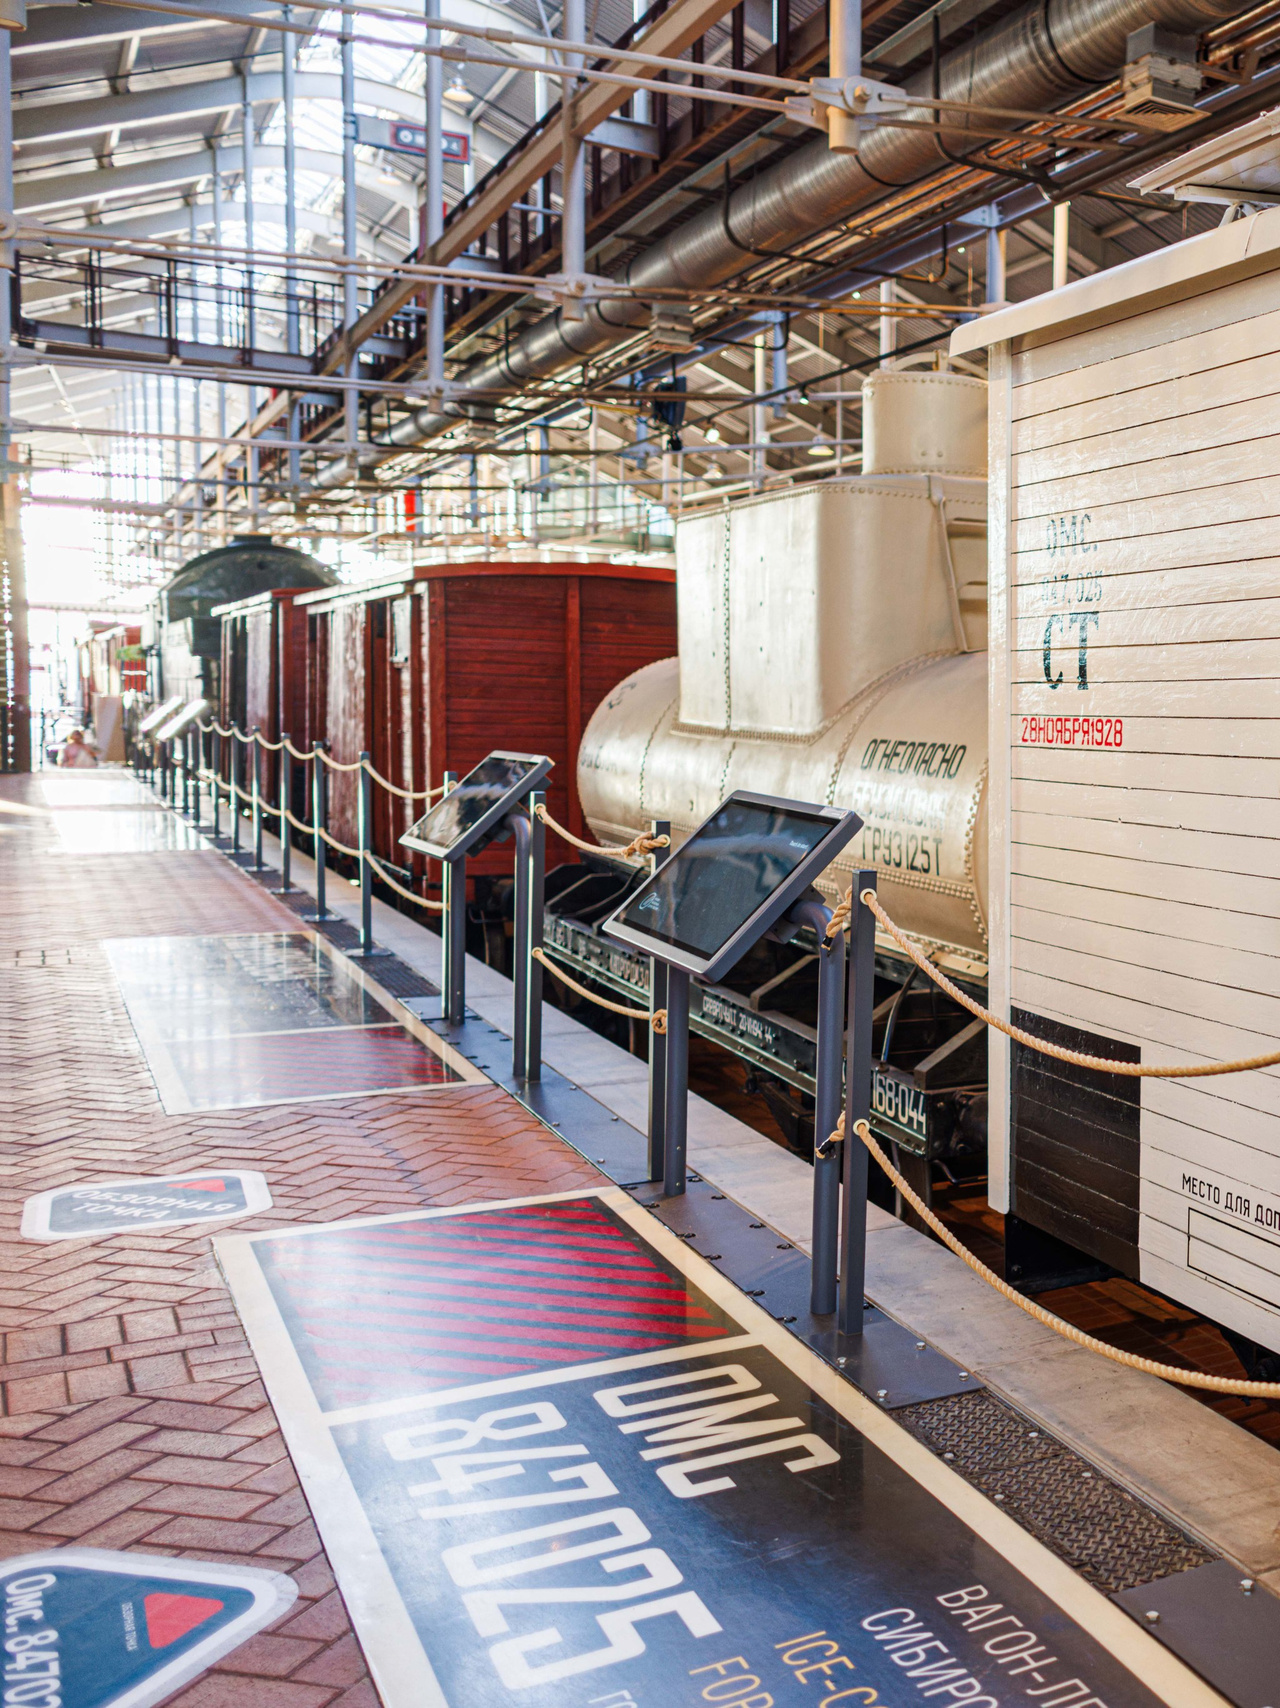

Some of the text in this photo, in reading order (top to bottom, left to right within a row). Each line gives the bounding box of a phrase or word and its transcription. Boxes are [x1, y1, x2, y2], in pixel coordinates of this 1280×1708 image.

[1043, 611, 1100, 690] СТ
[860, 738, 967, 779] ОГНЕОПАСНО
[72, 1190, 236, 1213] ОБЗОРНАЯ
[72, 1202, 170, 1219] ТОЧКА
[1182, 1173, 1221, 1205] МЕСТО
[1224, 1192, 1251, 1218] ДЛЯ
[593, 1364, 841, 1499] ОМС
[382, 1402, 723, 1691] 847025
